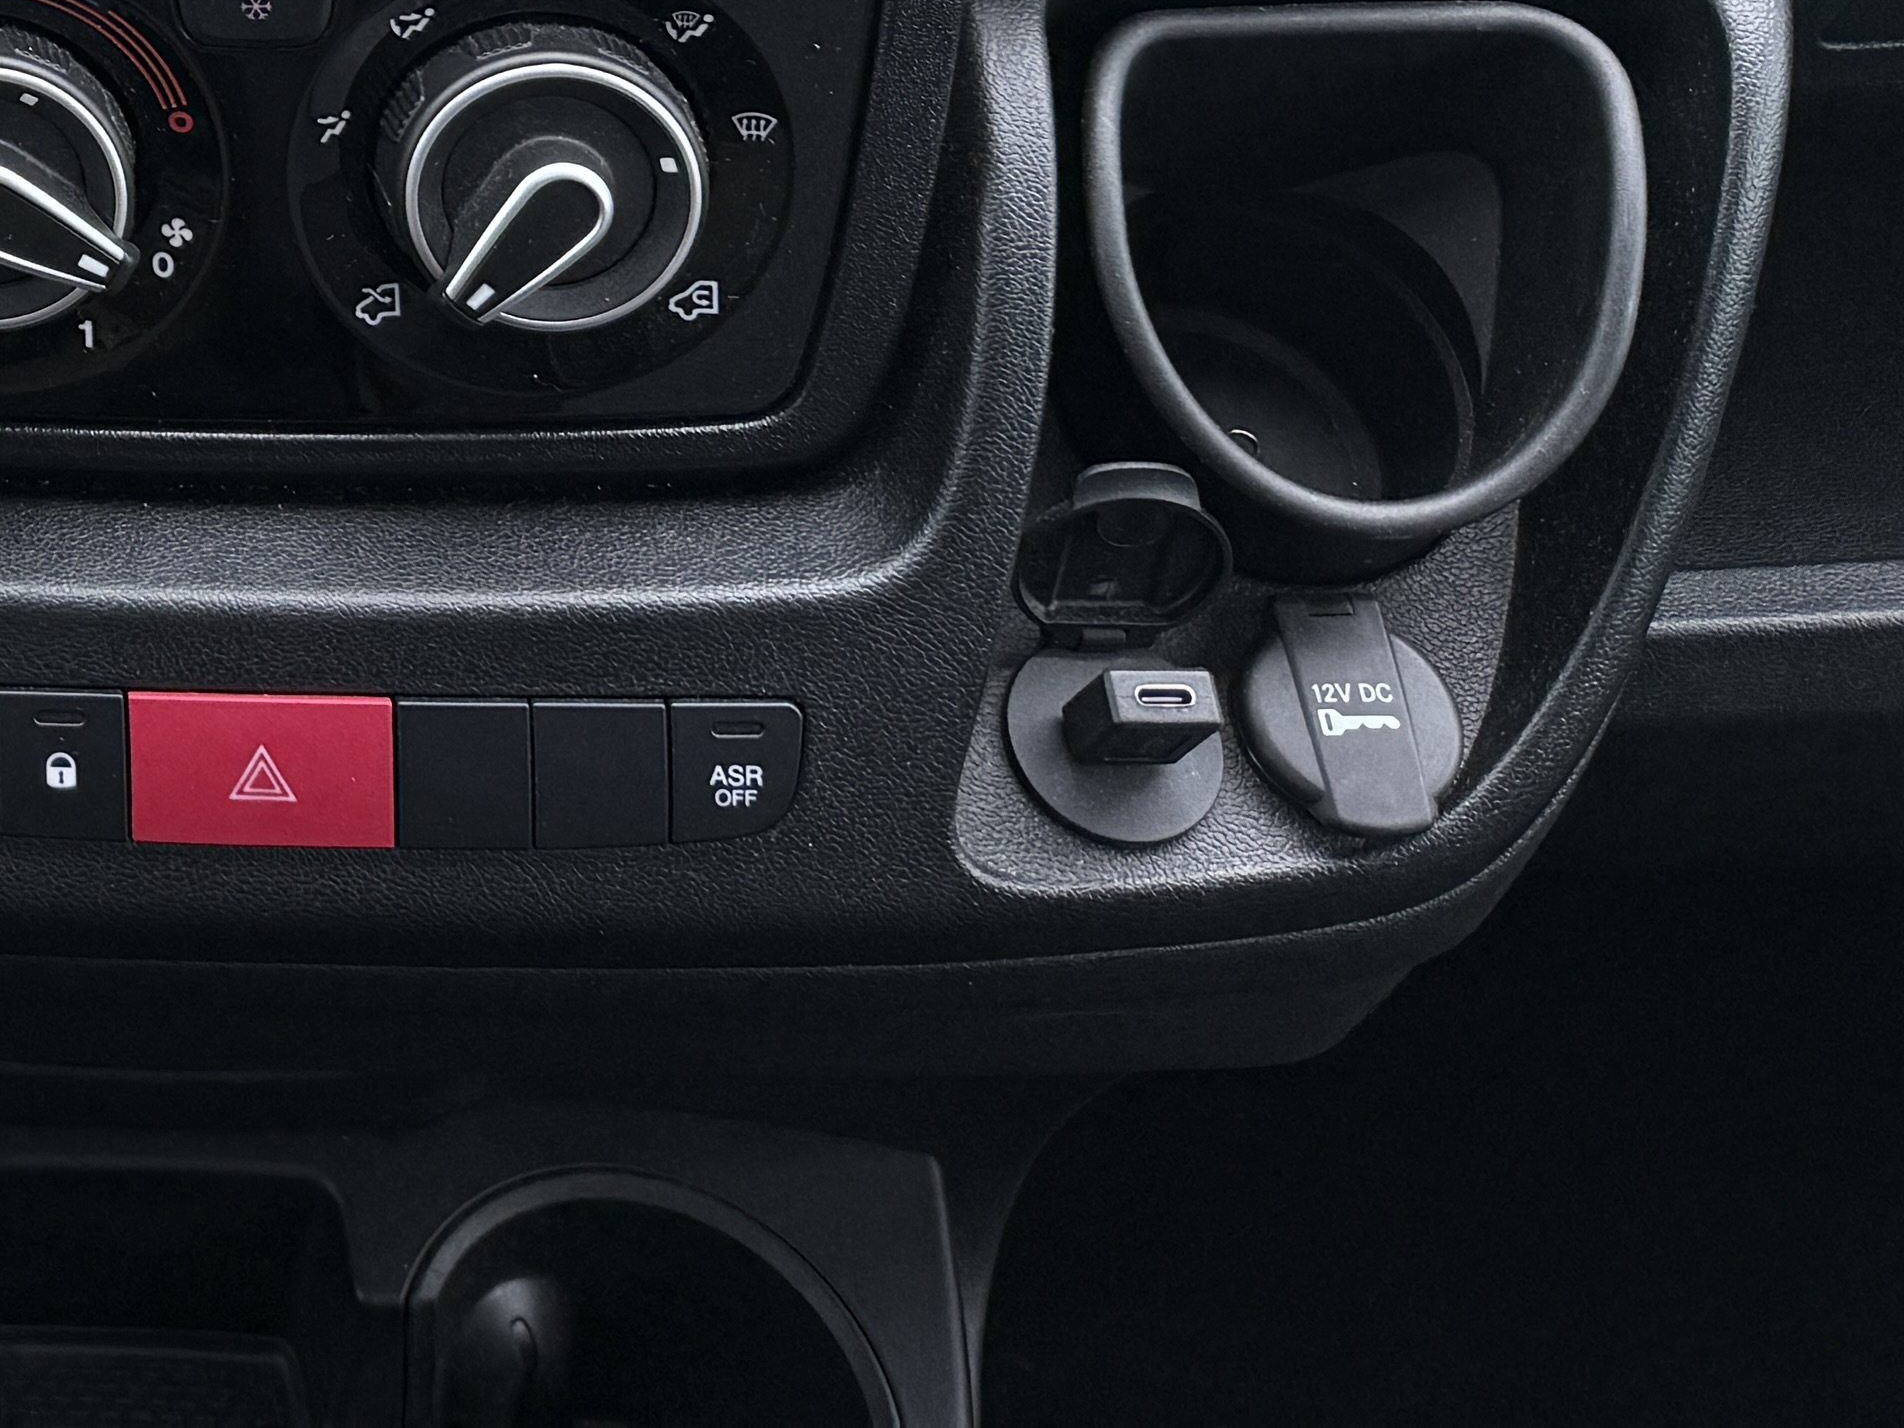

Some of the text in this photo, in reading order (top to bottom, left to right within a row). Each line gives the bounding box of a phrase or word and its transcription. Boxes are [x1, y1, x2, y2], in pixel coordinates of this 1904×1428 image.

[153, 249, 175, 278] 0
[78, 319, 94, 349] 1
[1311, 682, 1394, 704] 12V DC
[709, 764, 764, 787] ASR
[714, 788, 758, 807] OFF
